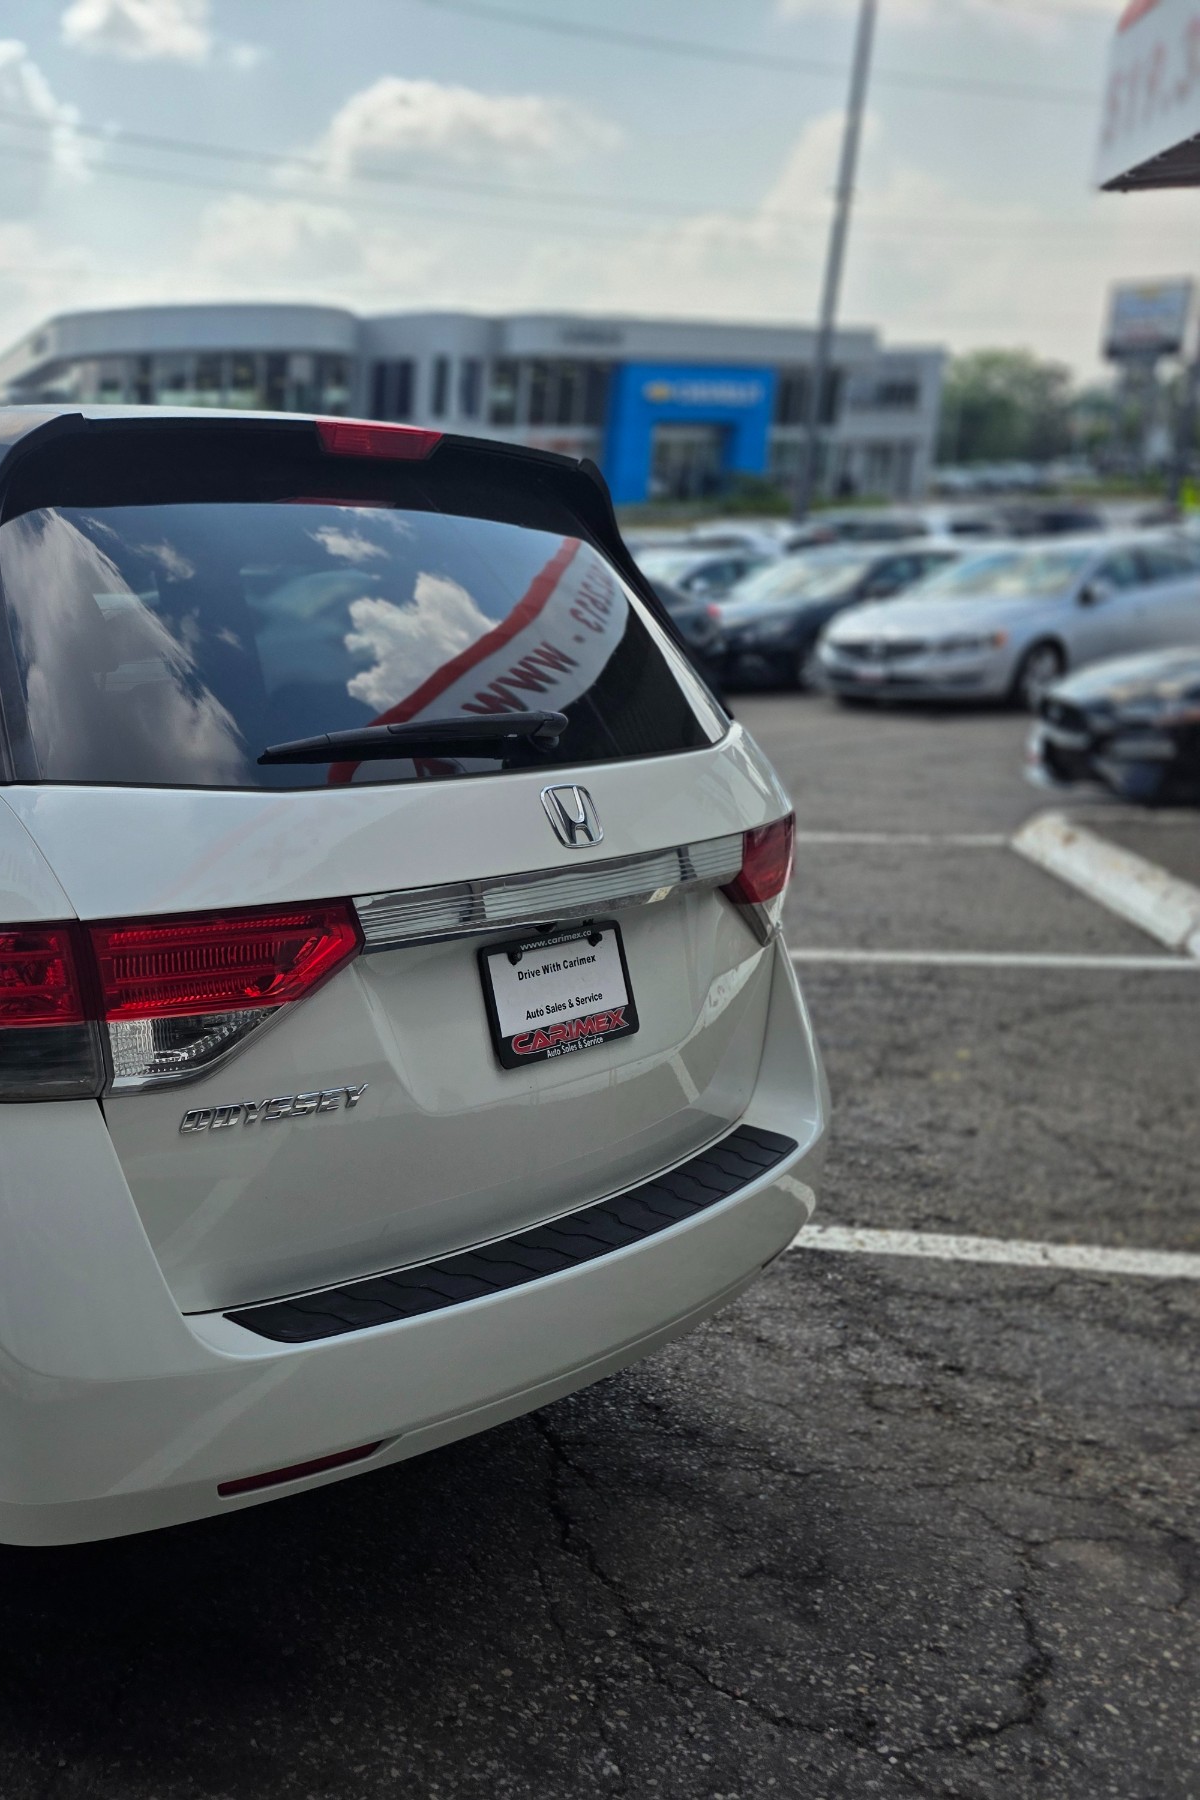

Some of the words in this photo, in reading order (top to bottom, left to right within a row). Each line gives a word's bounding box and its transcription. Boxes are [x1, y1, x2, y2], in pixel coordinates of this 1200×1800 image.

[520, 929, 592, 951] www.carimex.ca
[517, 966, 541, 982] Drive
[542, 961, 562, 975] With
[562, 954, 597, 970] Carimex
[526, 1007, 545, 1021] Auto
[545, 1001, 567, 1015] Sales
[568, 998, 575, 1009] &
[575, 991, 603, 1007] Service
[511, 1006, 629, 1055] CARIMEX
[547, 1048, 561, 1059] Auto
[561, 1043, 578, 1054] Sales
[578, 1041, 584, 1050] &
[583, 1036, 604, 1048] Service
[179, 1082, 369, 1134] ODYSSEY
